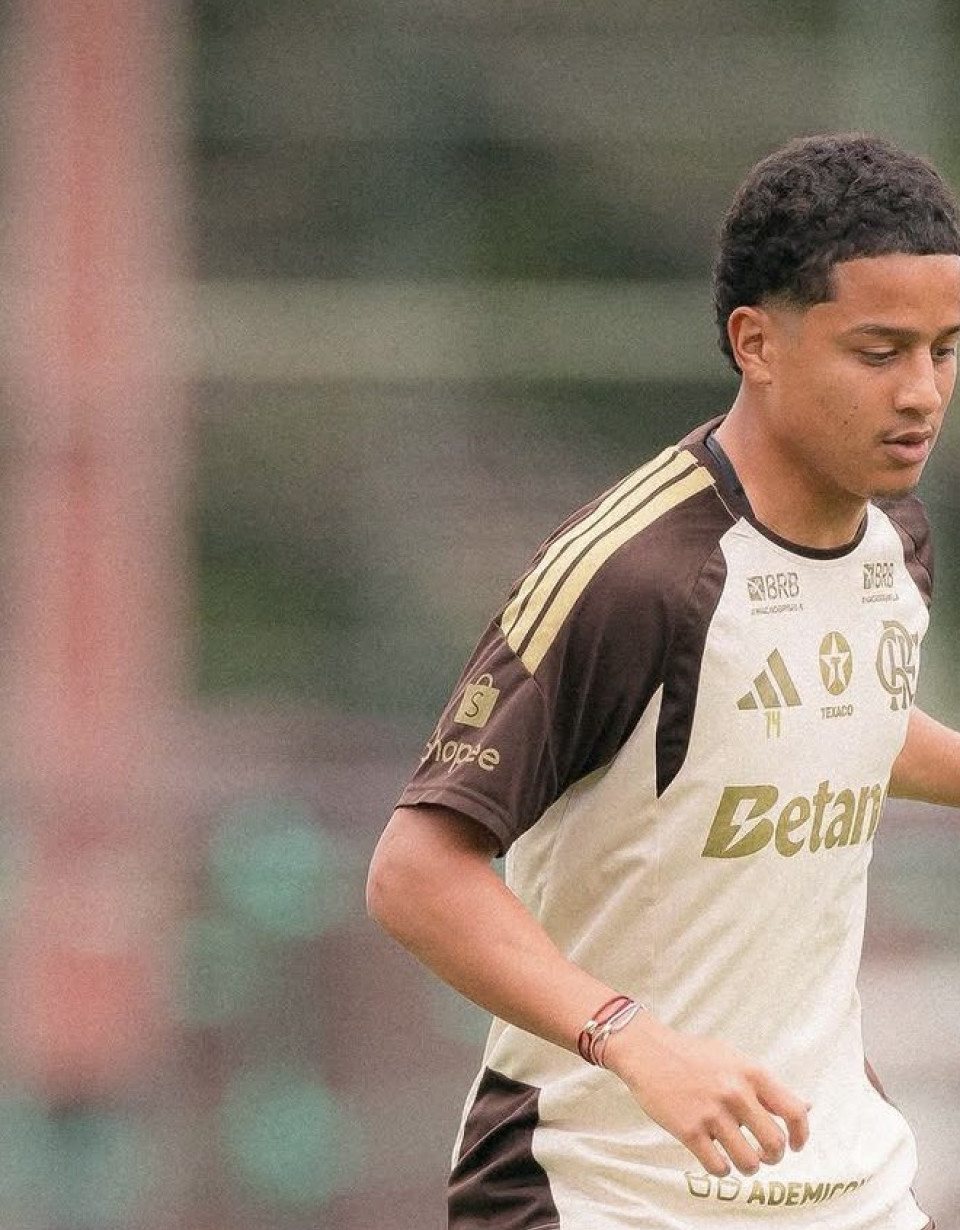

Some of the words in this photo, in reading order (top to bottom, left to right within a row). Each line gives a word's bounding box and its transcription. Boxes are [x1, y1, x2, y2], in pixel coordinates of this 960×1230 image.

[765, 572, 800, 600] BRB
[464, 691, 484, 718] S
[820, 704, 854, 719] TEXACO
[701, 780, 883, 859] Betan
